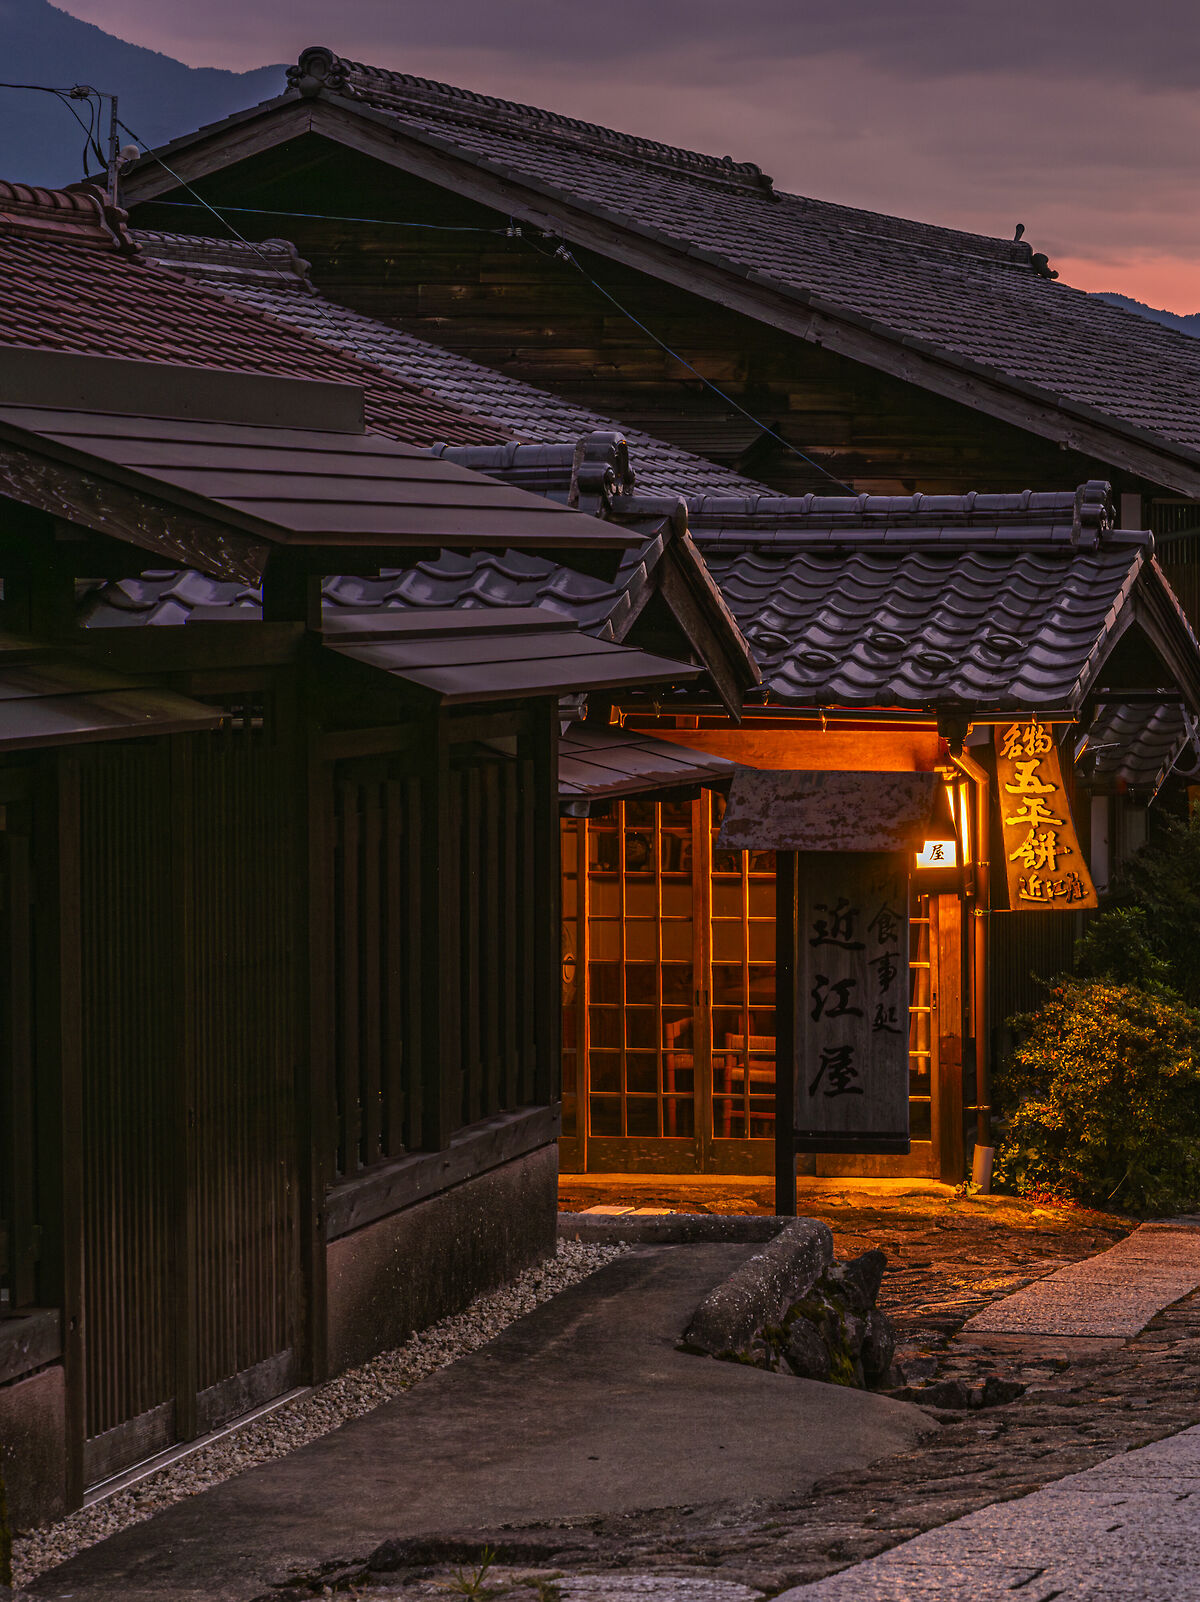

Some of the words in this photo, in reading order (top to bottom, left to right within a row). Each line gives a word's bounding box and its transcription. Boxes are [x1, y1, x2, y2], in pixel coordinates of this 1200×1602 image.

[1000, 723, 1053, 759] 名物
[1005, 758, 1072, 872] 五平餅
[929, 844, 945, 860] 屋
[1019, 871, 1089, 903] 近江屋
[809, 897, 866, 1098] 近江屋
